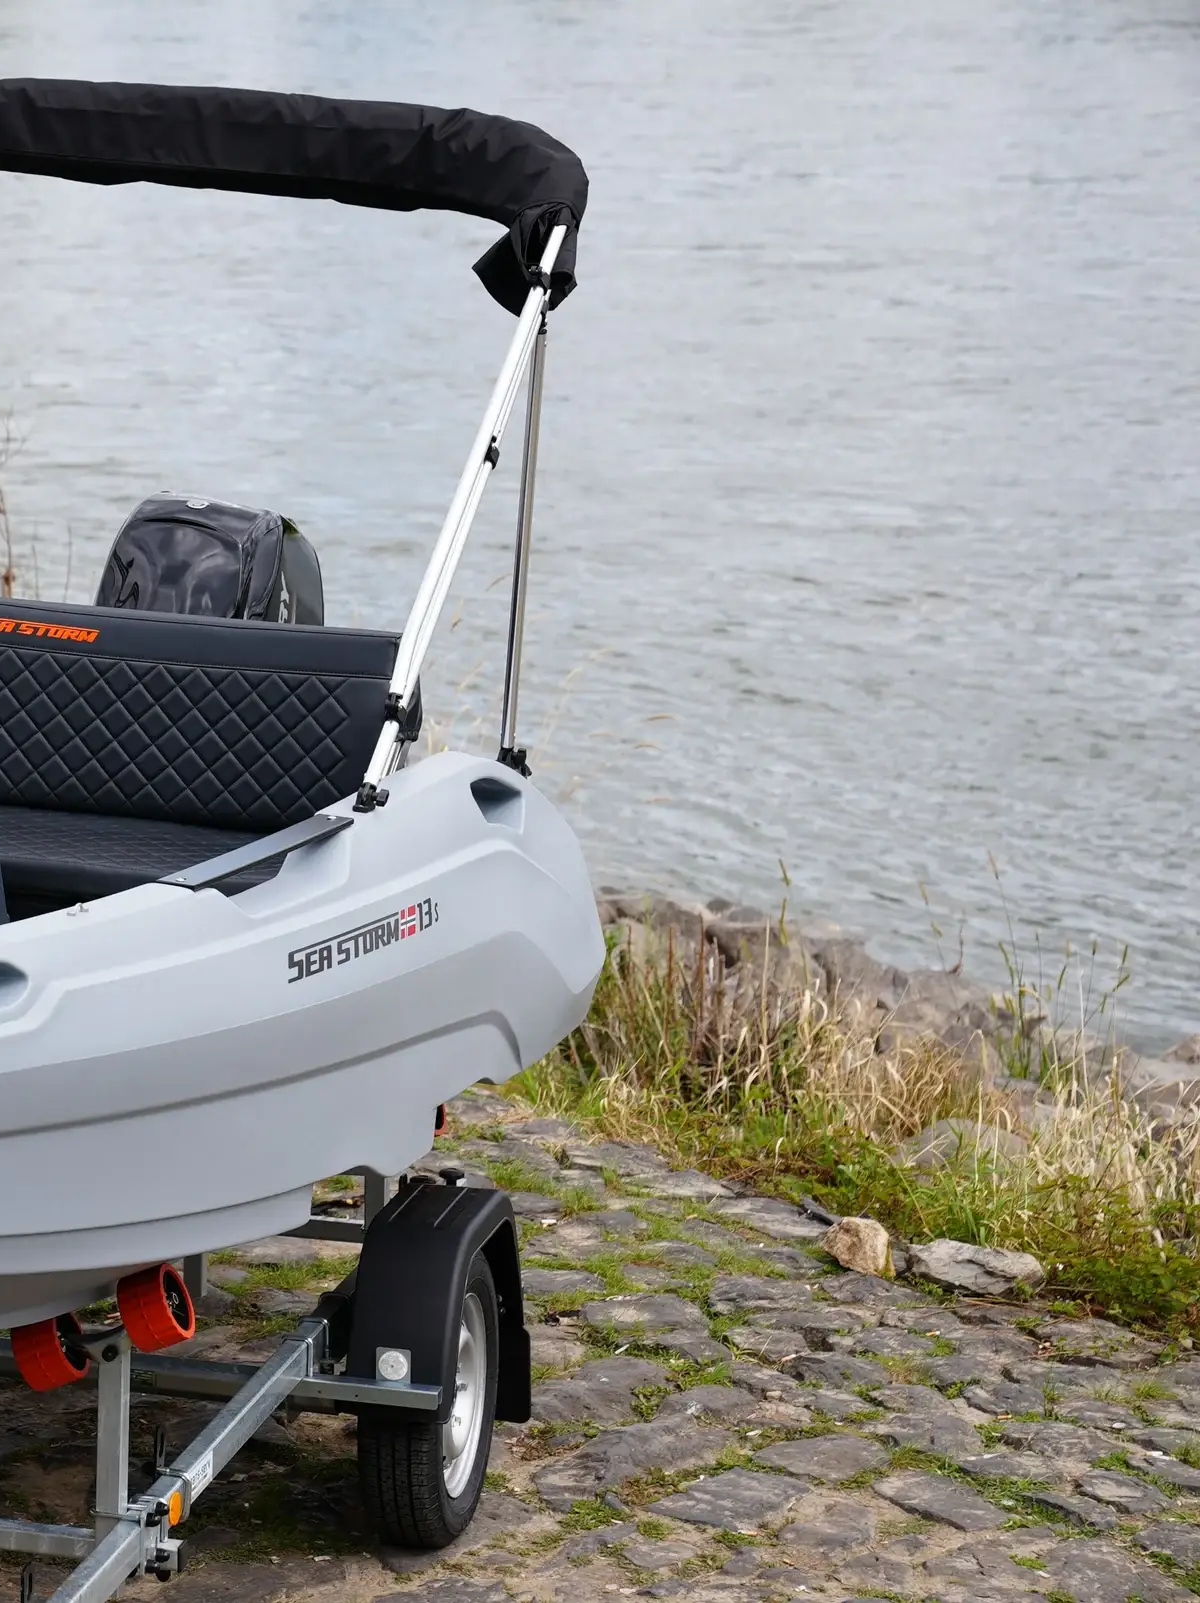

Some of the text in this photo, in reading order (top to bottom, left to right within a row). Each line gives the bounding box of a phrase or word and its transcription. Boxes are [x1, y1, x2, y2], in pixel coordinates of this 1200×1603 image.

[16, 622, 99, 643] STORM
[287, 944, 333, 984] SEA
[337, 917, 400, 966] STORM
